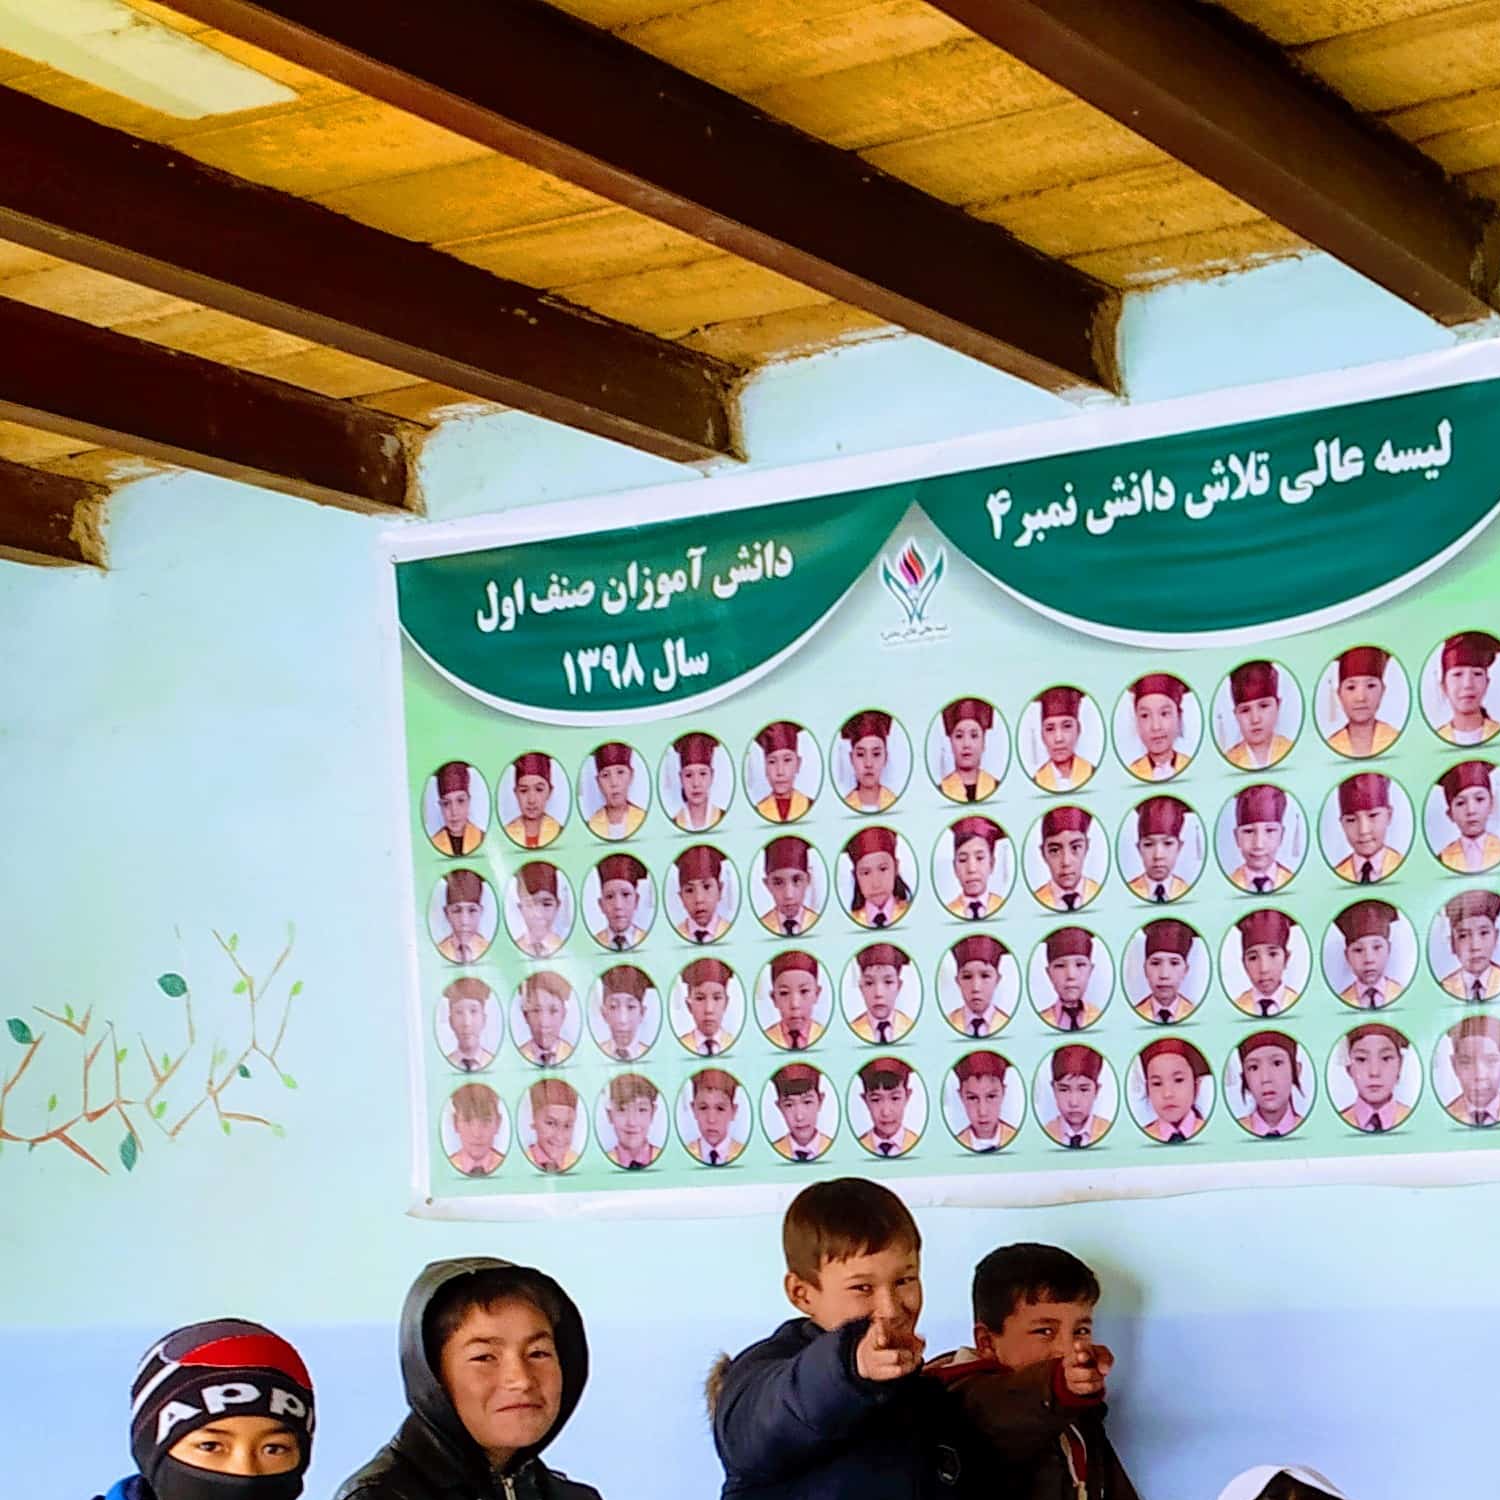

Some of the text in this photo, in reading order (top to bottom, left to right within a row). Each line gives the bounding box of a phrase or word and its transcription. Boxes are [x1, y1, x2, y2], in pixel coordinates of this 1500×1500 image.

[1280, 438, 1364, 504] عالی
[1375, 419, 1452, 479] لیسه
[1086, 470, 1175, 534] دانش
[1185, 452, 1270, 519] تلاش
[477, 540, 793, 632] دانش آموزان صنف اول
[563, 638, 709, 694] سال ۱۳۹۸
